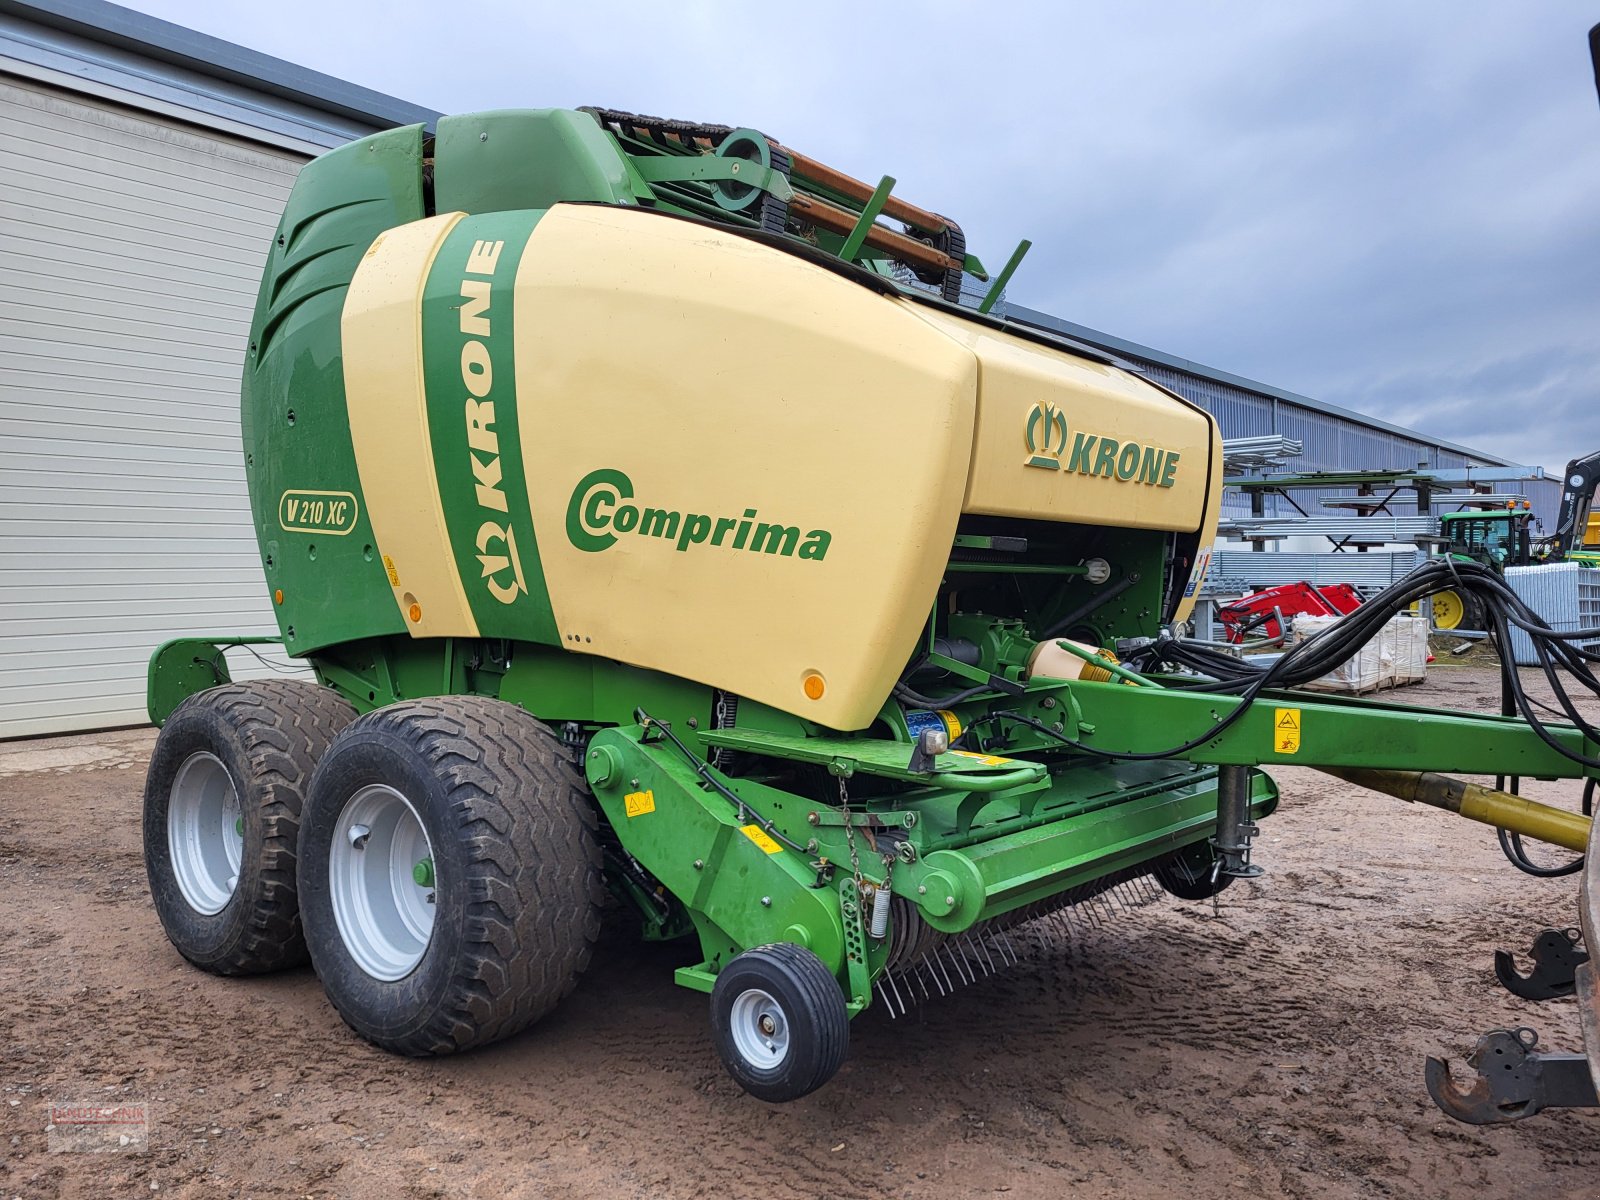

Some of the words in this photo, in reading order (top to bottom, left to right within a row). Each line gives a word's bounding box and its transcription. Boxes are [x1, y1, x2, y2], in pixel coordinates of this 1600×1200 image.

[459, 239, 509, 513] KRONE
[1064, 430, 1181, 488] KRONE
[287, 499, 299, 522] V
[300, 500, 324, 524] 210
[325, 500, 347, 526] XC
[565, 468, 832, 561] Comprima
